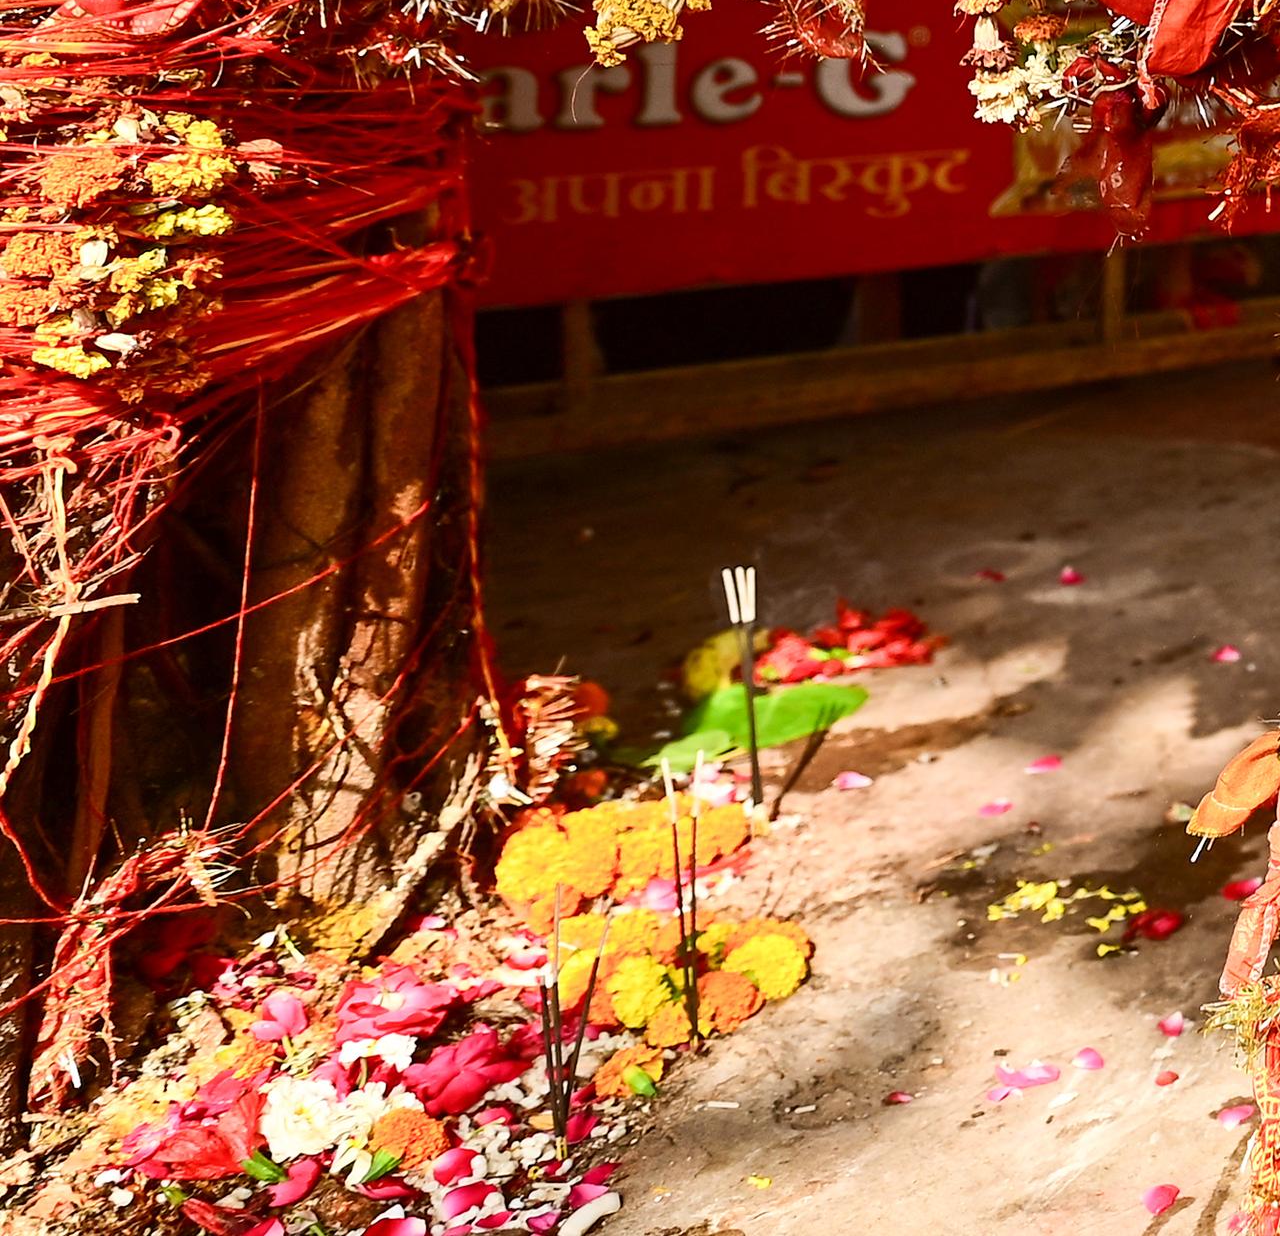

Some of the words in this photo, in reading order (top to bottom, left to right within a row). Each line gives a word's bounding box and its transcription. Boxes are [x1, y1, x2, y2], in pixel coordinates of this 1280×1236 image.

[479, 28, 916, 134] arle-G
[504, 166, 718, 225] अपना
[741, 144, 972, 218] बिस्कुट
